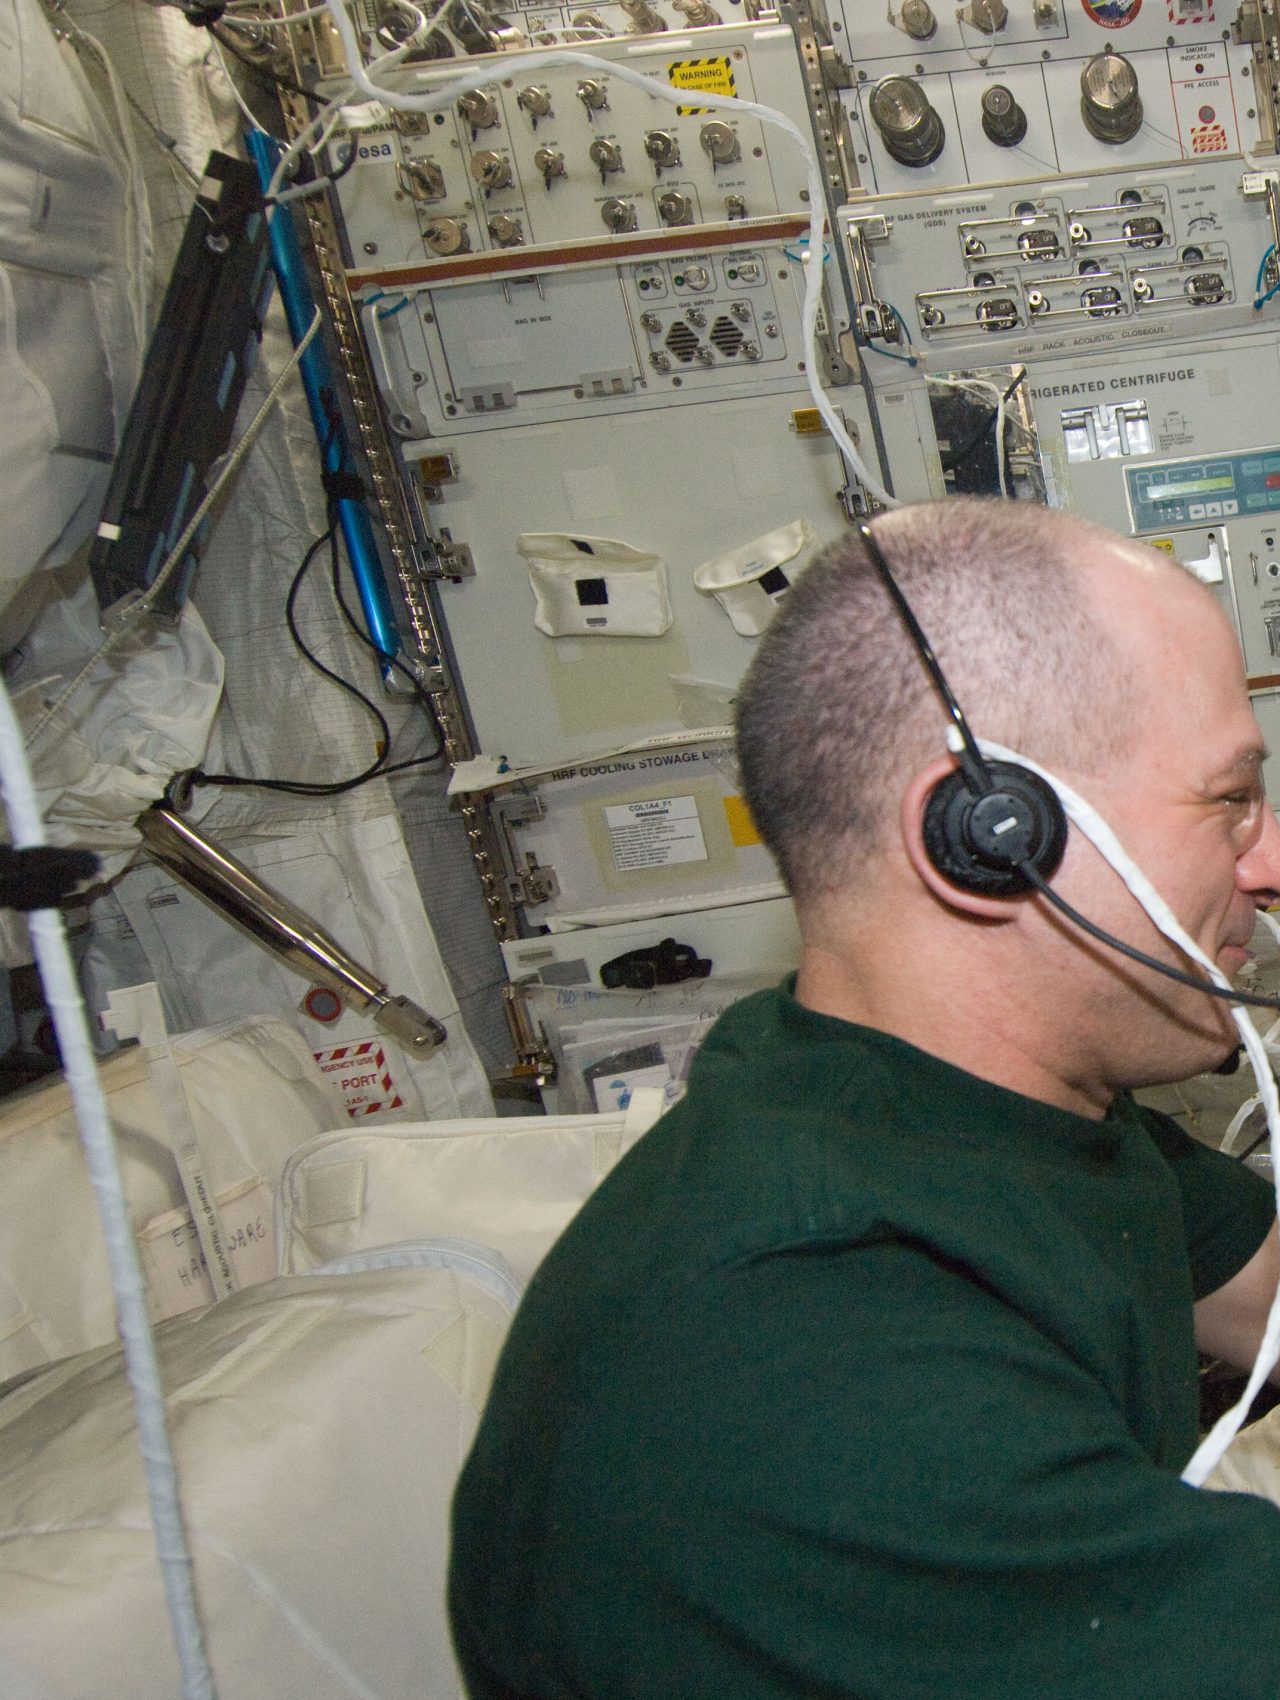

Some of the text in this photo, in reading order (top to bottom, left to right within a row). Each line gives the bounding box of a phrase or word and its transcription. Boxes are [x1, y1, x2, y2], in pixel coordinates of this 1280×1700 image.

[1185, 46, 1208, 54] SMOKE
[1180, 53, 1216, 62] INDICATION
[679, 69, 723, 81] WARNING
[1197, 80, 1220, 88] ACCESS
[358, 141, 392, 158] esa
[897, 213, 914, 222] GAS
[916, 209, 954, 220] DELIVERY
[956, 205, 987, 214] SYSTEM
[924, 219, 946, 229] (GDS)
[1208, 277, 1219, 285] OFF
[539, 315, 553, 323] BOX
[1018, 326, 1165, 355] HRF RACK ACOUSTIC CLOSEOUT
[1110, 368, 1196, 389] CENTRIFUGE
[552, 768, 577, 782] HRF
[579, 762, 636, 778] COOLING
[639, 752, 700, 769] STOWAGE
[628, 800, 673, 812] COL1A4_F1
[356, 1056, 375, 1066] USE
[341, 1073, 378, 1090] PORT
